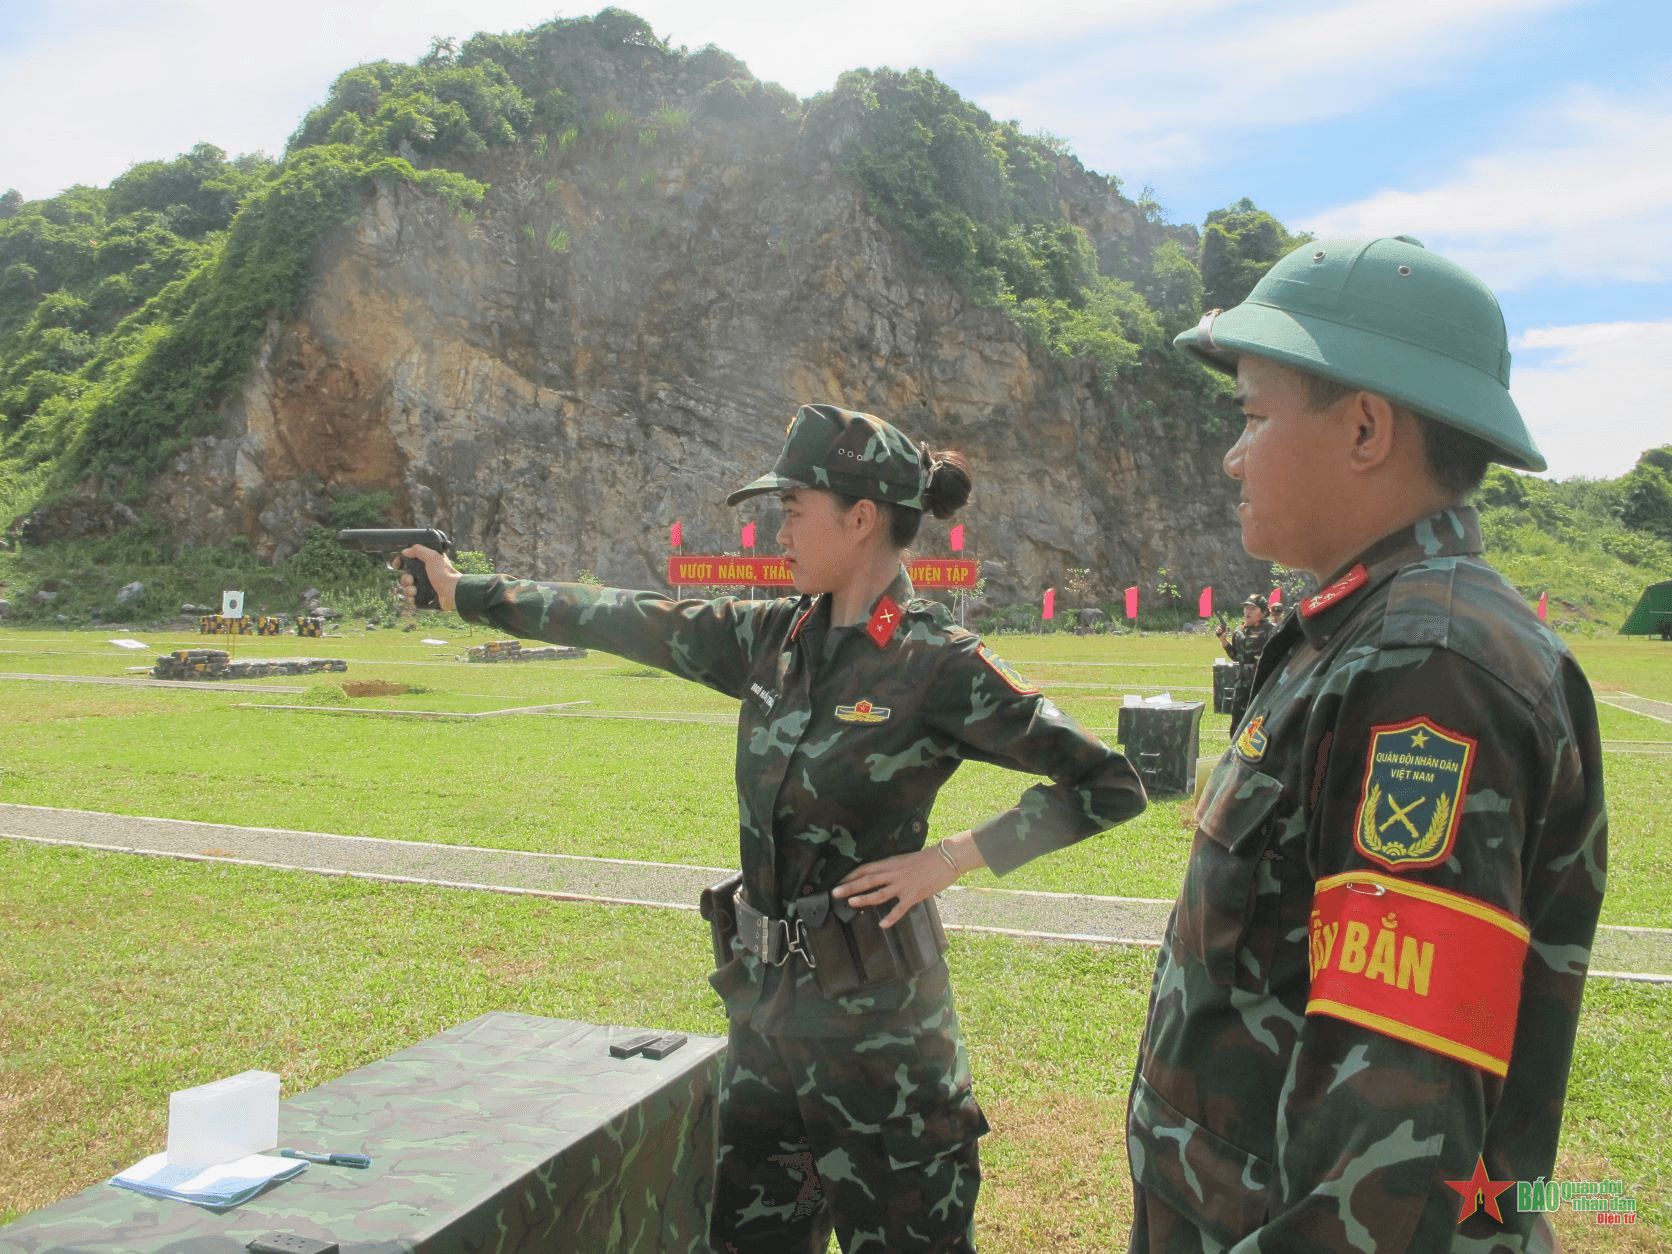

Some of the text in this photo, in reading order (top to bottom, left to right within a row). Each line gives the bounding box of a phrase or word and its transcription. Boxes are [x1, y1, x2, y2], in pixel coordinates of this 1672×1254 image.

[679, 562, 712, 581] VƯỢT
[945, 564, 969, 585] TẬP
[1376, 750, 1459, 773] QUÂN ĐỘI NHÂN DÂN
[1391, 767, 1435, 783] VIỆT NAM
[1338, 911, 1435, 997] BẮN
